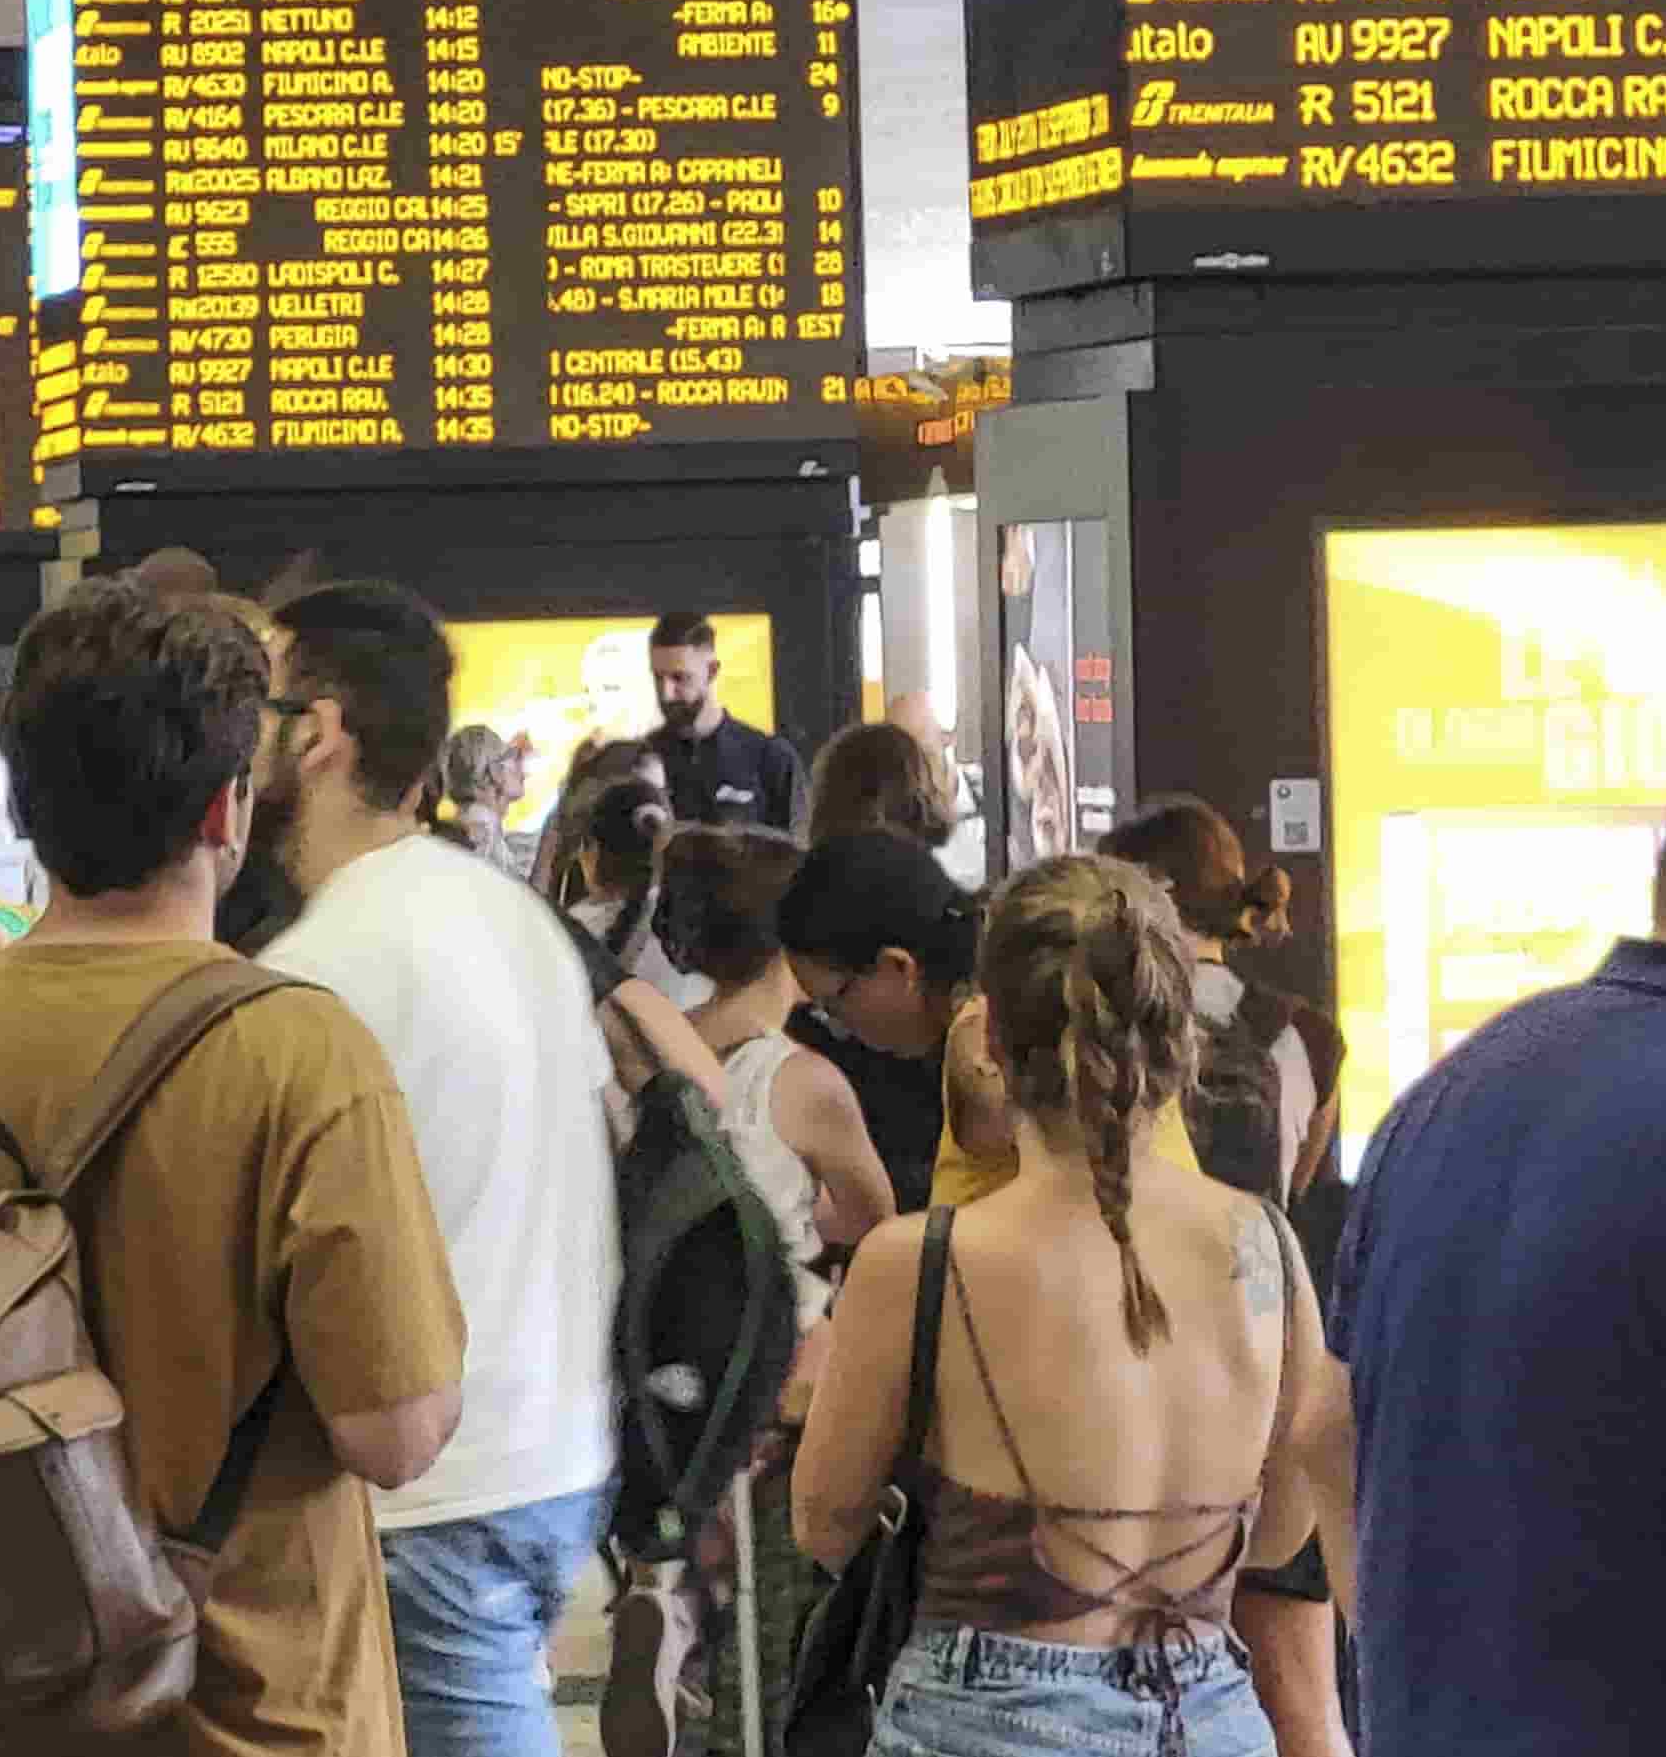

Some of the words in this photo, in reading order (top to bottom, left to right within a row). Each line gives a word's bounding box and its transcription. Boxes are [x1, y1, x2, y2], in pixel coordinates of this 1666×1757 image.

[1297, 24, 1342, 63] AV
[1352, 18, 1450, 60] 9927
[1489, 15, 1623, 58] NAPOLI
[1300, 86, 1332, 124] R
[1354, 81, 1435, 121] 5121
[1491, 76, 1613, 119] ROCCA
[1356, 142, 1454, 186] 4632
